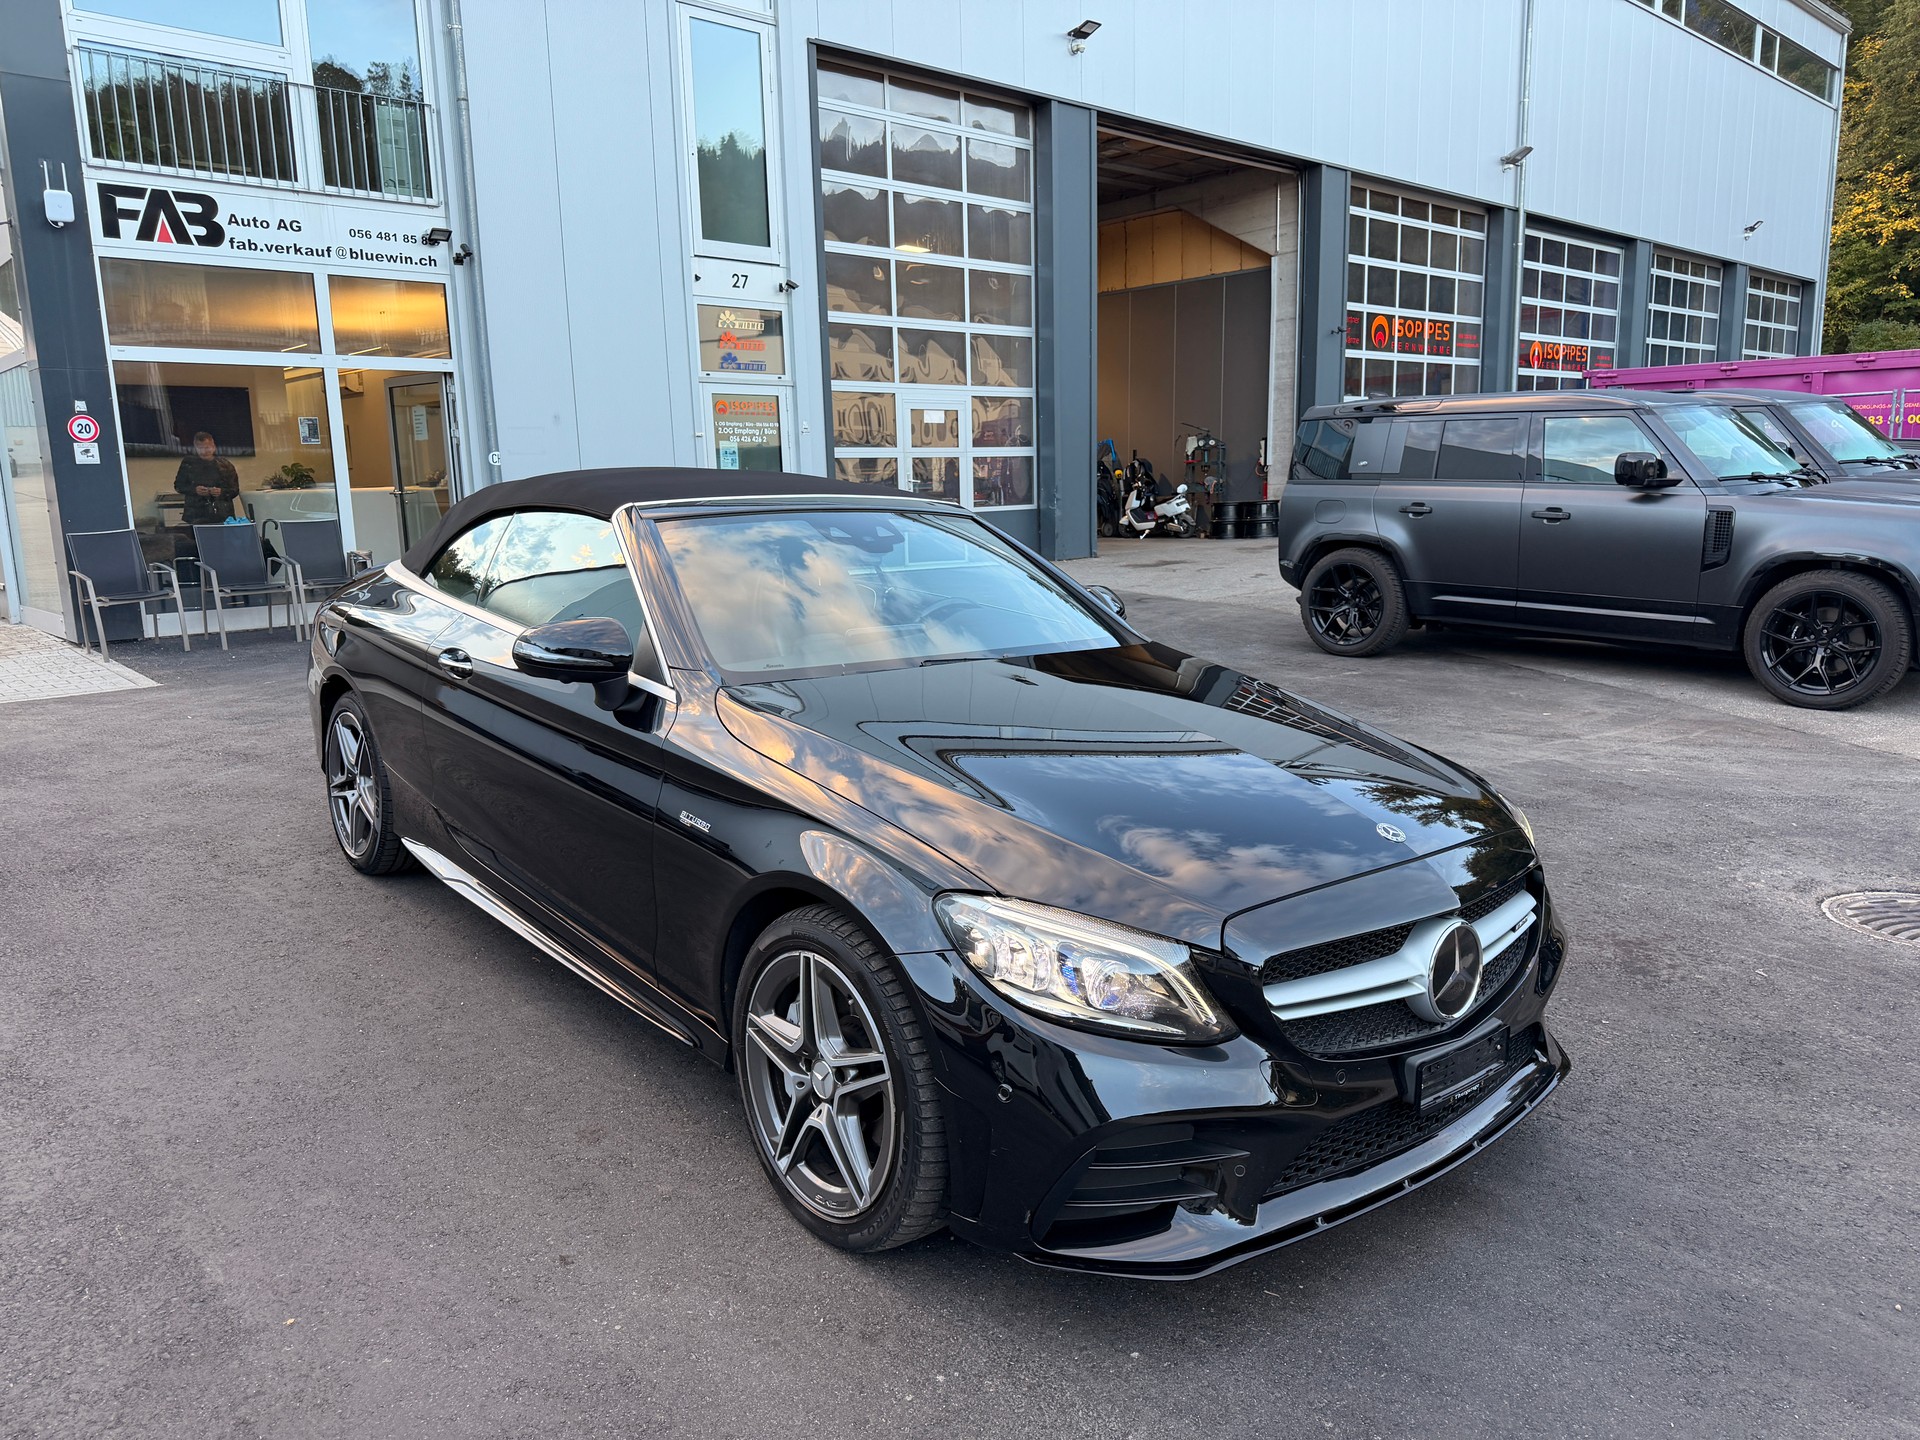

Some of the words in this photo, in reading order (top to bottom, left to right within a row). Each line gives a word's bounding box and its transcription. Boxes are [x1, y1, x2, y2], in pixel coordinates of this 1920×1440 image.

[96, 182, 226, 248] FAB
[227, 213, 270, 229] Auto
[276, 218, 302, 232] AG
[349, 228, 372, 240] 056
[376, 231, 398, 242] 481
[402, 233, 418, 244] 85
[731, 273, 749, 289] 27
[1391, 318, 1450, 342] ISOPIPES
[1543, 343, 1587, 362] ISOPIPES
[76, 423, 92, 434] 20
[680, 810, 711, 830] BITURBO
